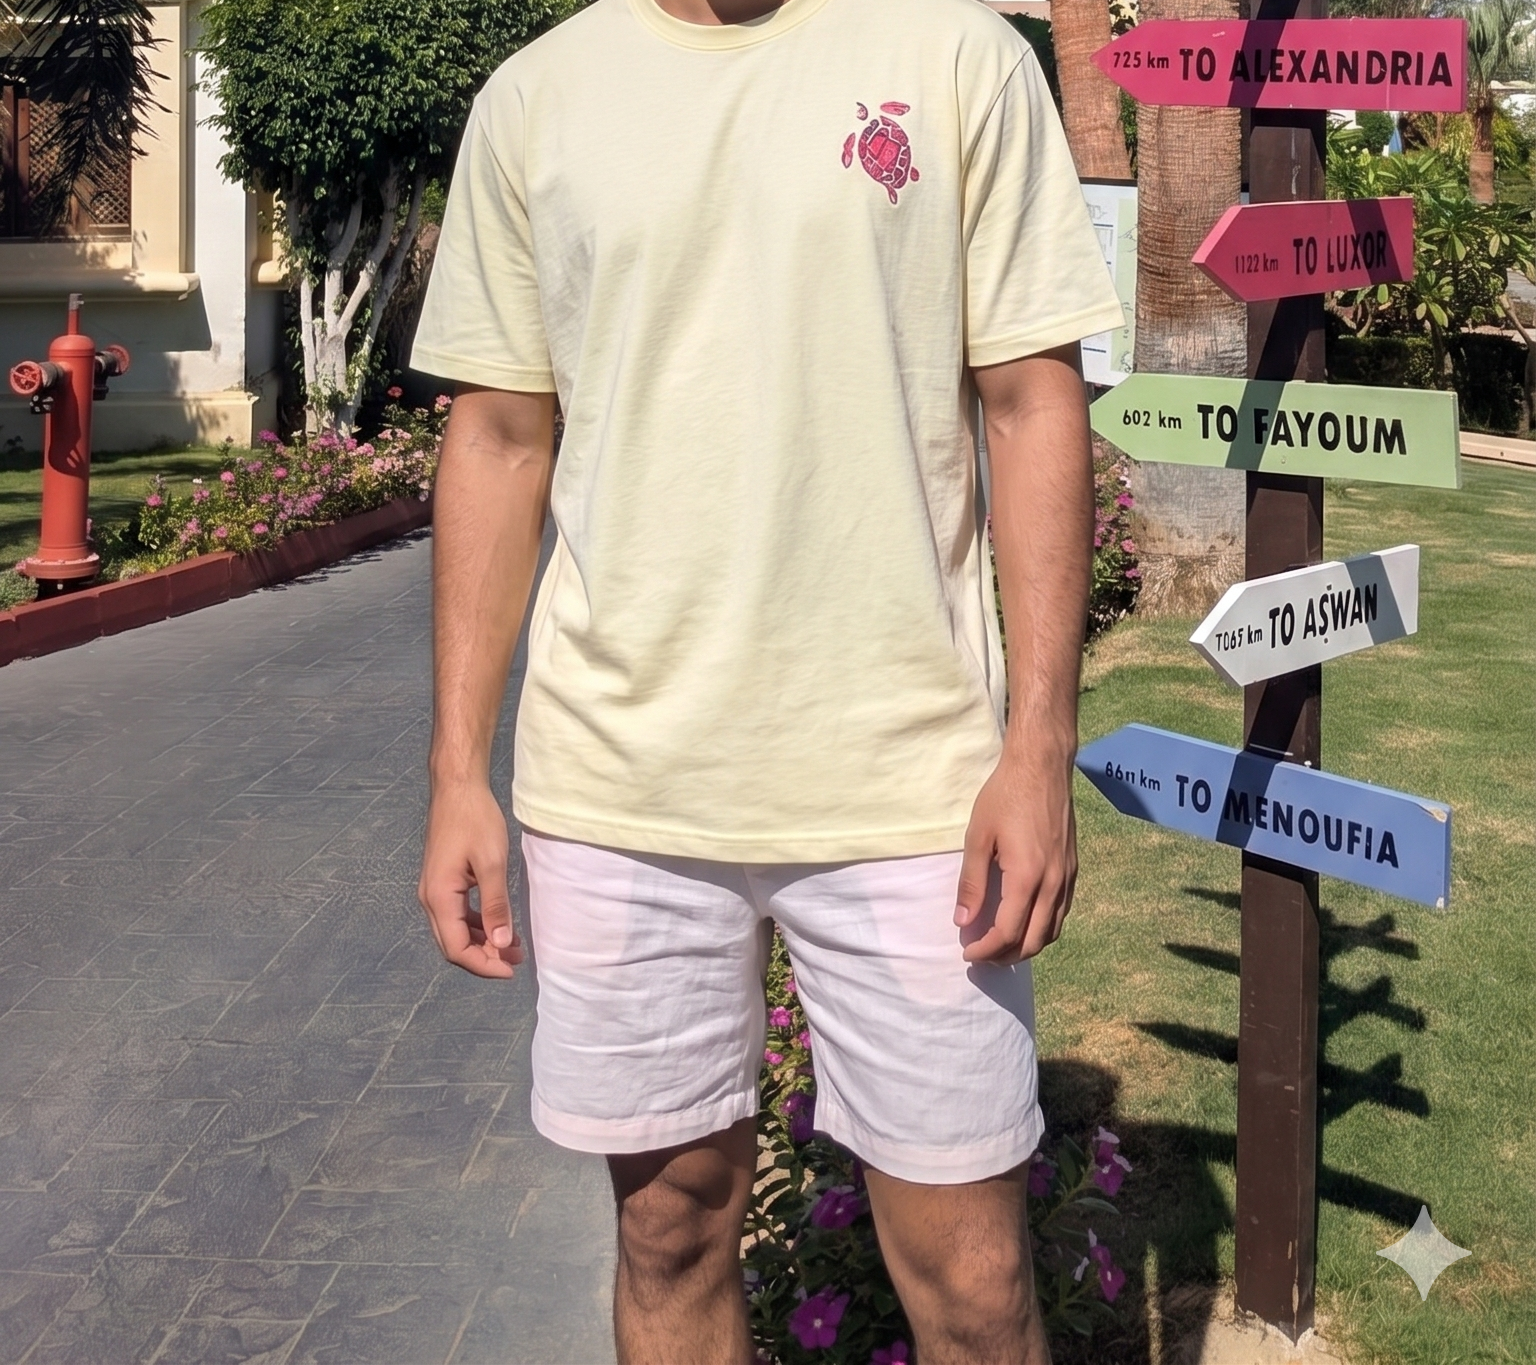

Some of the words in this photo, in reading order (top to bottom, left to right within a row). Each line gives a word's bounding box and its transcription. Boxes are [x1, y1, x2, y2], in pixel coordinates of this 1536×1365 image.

[1113, 51, 1141, 69] 725
[1147, 50, 1170, 69] km
[1180, 46, 1216, 82] TO
[1229, 48, 1453, 87] ALEXANDRIA
[1235, 254, 1260, 274] 1122
[1263, 253, 1279, 272] km
[1293, 236, 1317, 275] TO
[1327, 230, 1387, 274] LUXOR
[1122, 408, 1151, 427] 602
[1158, 410, 1182, 429] km
[1197, 403, 1238, 442] TO
[1254, 408, 1407, 456] FAYOUM
[1247, 624, 1263, 644] km
[1268, 602, 1295, 649] TO
[1303, 582, 1377, 640] ASWAN
[1139, 768, 1161, 792] km
[1176, 774, 1212, 813] TO
[1223, 787, 1400, 869] MENOUFIA
